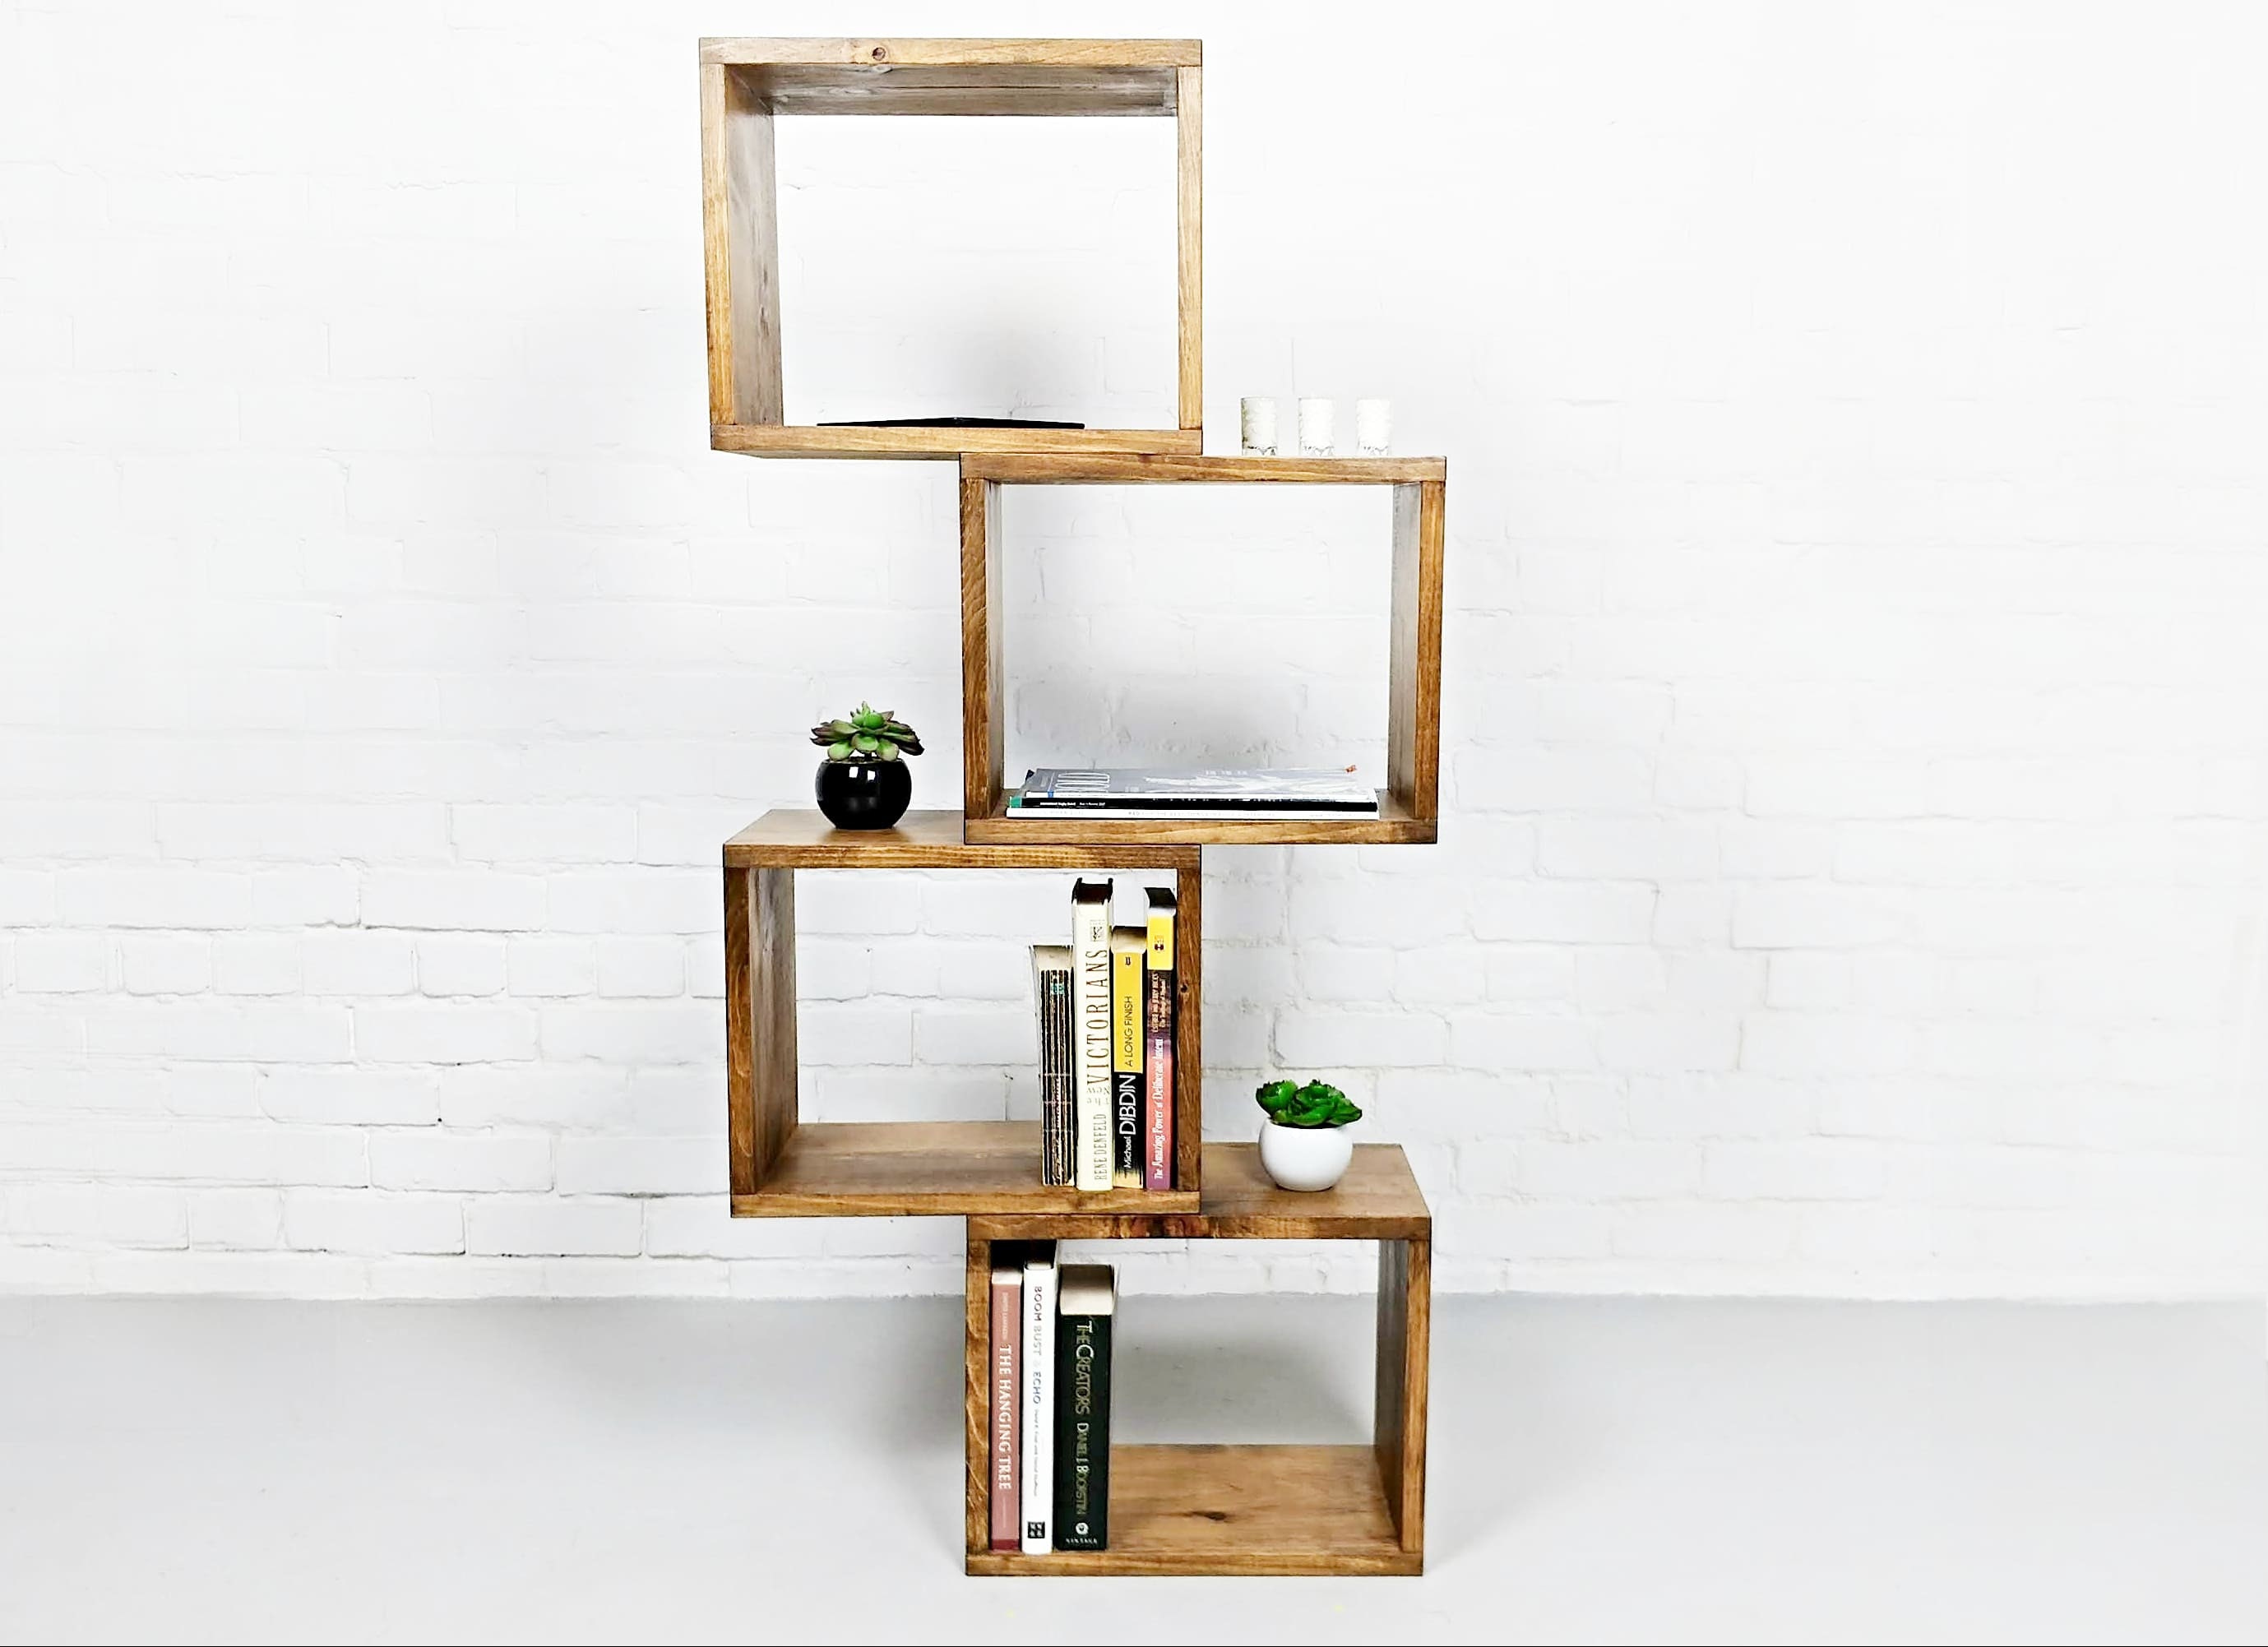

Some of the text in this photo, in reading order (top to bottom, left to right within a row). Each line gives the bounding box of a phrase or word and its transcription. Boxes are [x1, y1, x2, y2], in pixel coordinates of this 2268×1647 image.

[1085, 949, 1109, 1085] VICTORIANS
[1124, 996, 1133, 1027] FINISH
[1124, 1028, 1133, 1058] LONG
[1151, 1039, 1164, 1060] Intent
[1151, 1061, 1164, 1100] Deliberate
[1155, 1101, 1164, 1109] of
[1119, 1075, 1136, 1168] Michael DIBDIN
[1151, 1110, 1164, 1134] Power
[1092, 1113, 1108, 1181] RENE DENFELD
[1151, 1136, 1165, 1168] Amazing
[1154, 1168, 1164, 1179] The
[1034, 1285, 1043, 1321] BOOM
[1033, 1325, 1043, 1356] BUST
[998, 1344, 1013, 1376] THE
[1076, 1320, 1095, 1415] THE CREATORS
[1033, 1371, 1042, 1404] ECHO
[998, 1379, 1013, 1452] HANGING
[998, 1455, 1012, 1490] TREE
